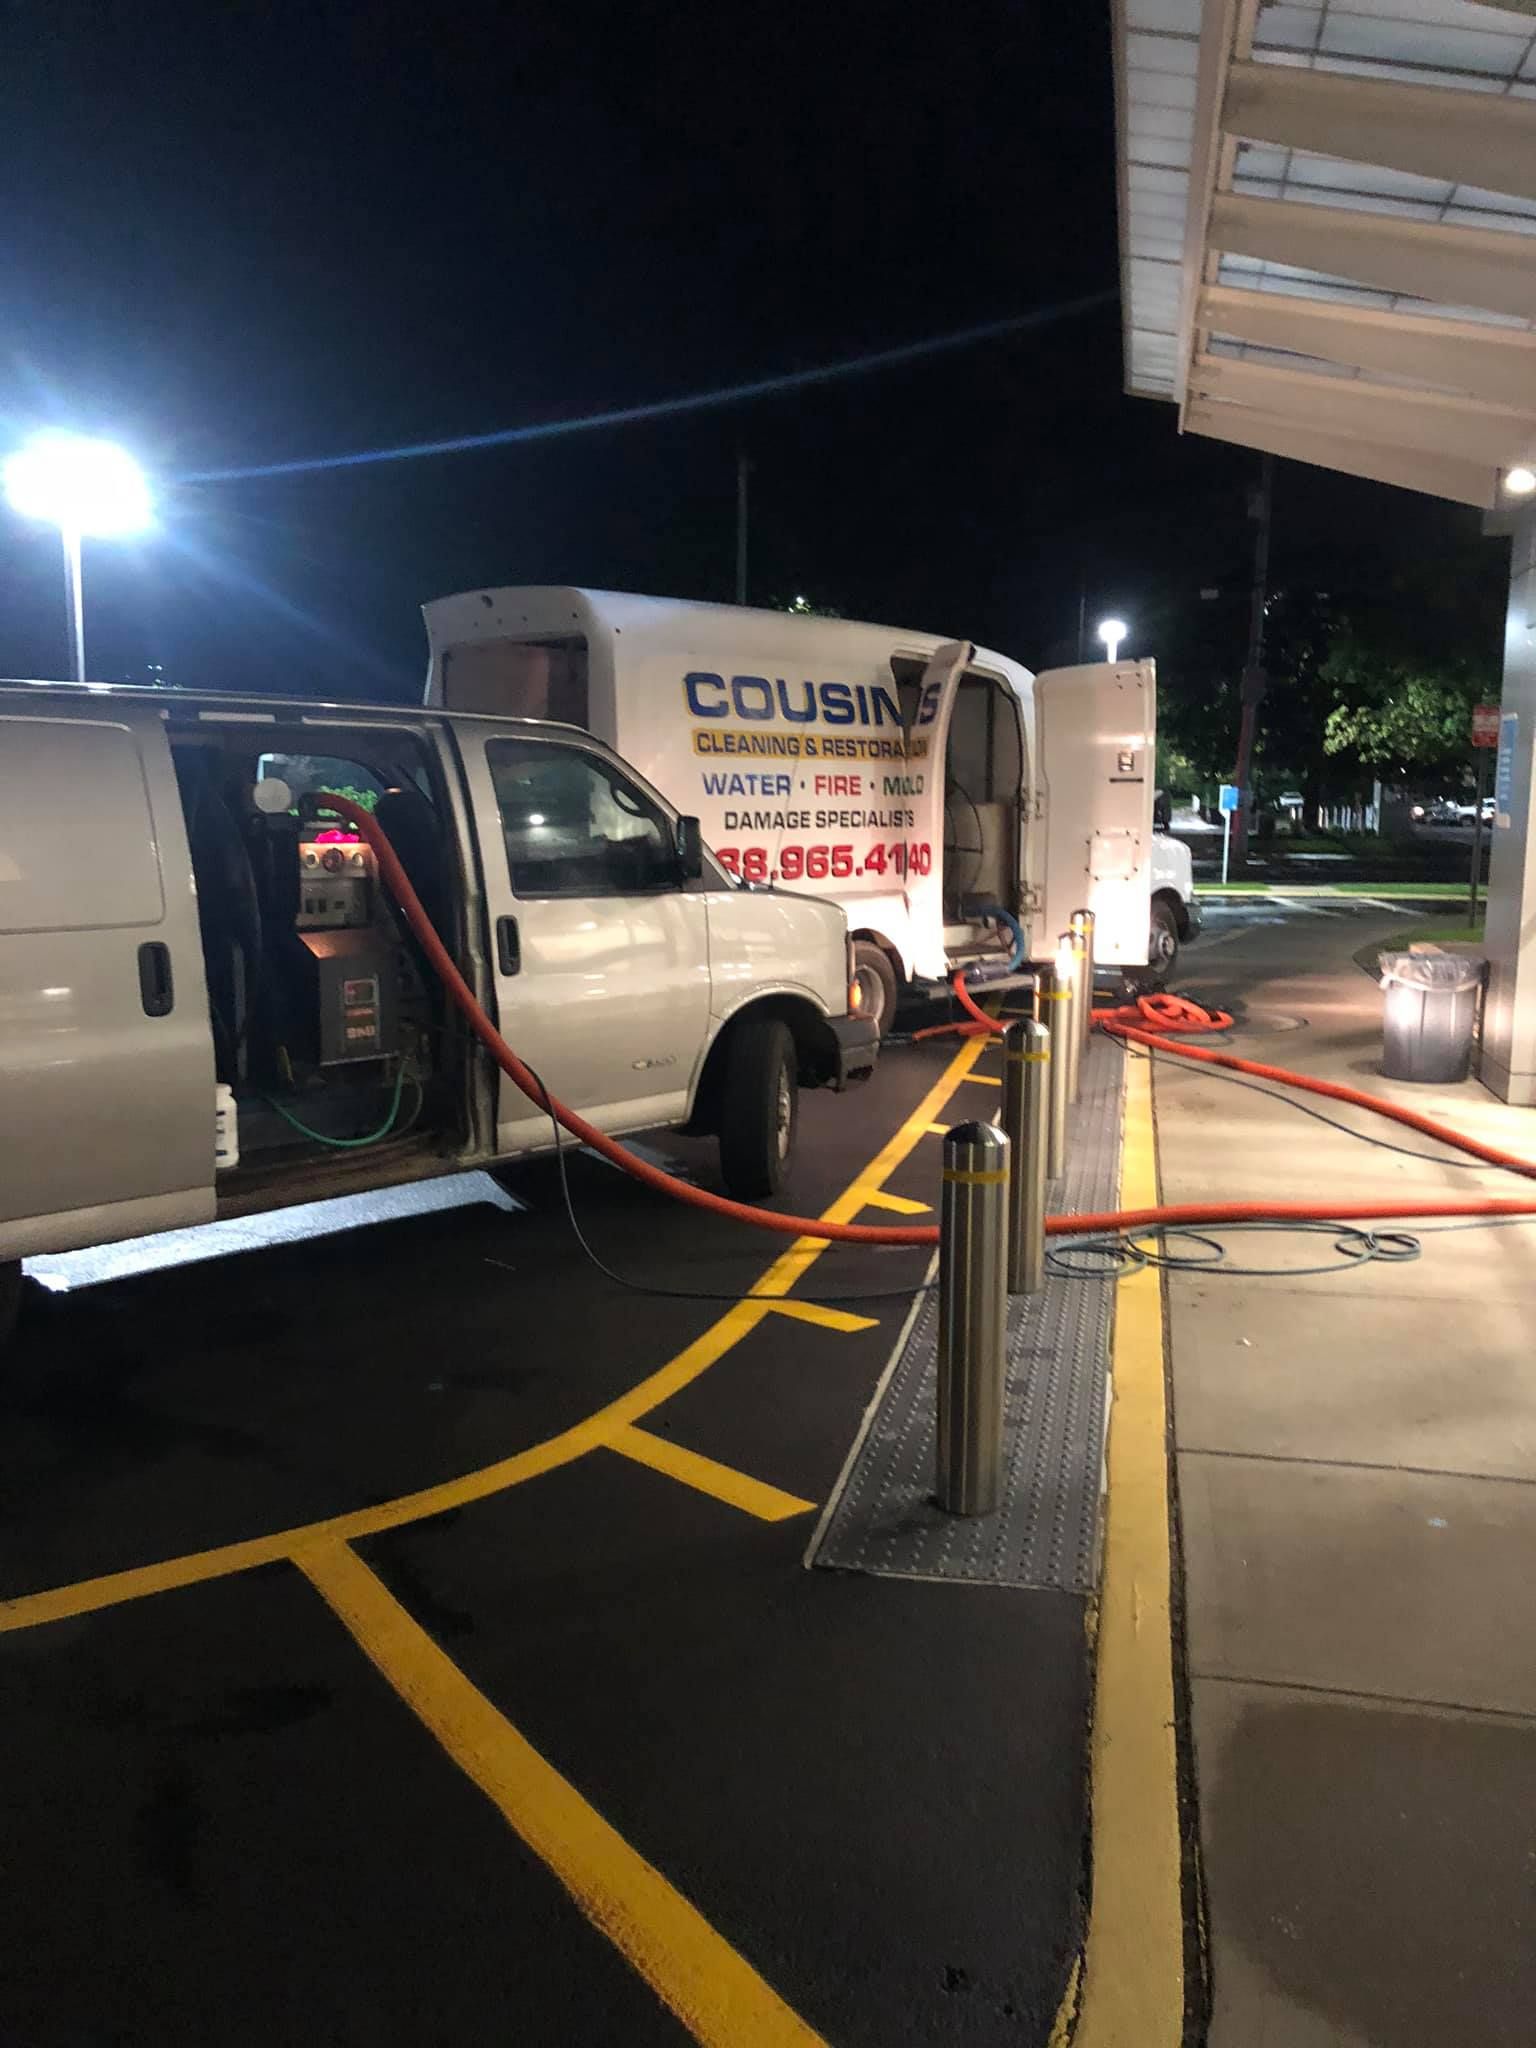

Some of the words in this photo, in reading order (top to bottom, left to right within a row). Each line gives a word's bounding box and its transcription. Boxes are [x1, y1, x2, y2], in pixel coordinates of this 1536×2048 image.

[684, 671, 942, 727] COUSINS
[696, 732, 800, 756] CLEANING
[805, 738, 818, 756] &
[702, 773, 792, 796] WATER
[814, 775, 862, 796] FIRE
[724, 810, 810, 831] DAMAGE
